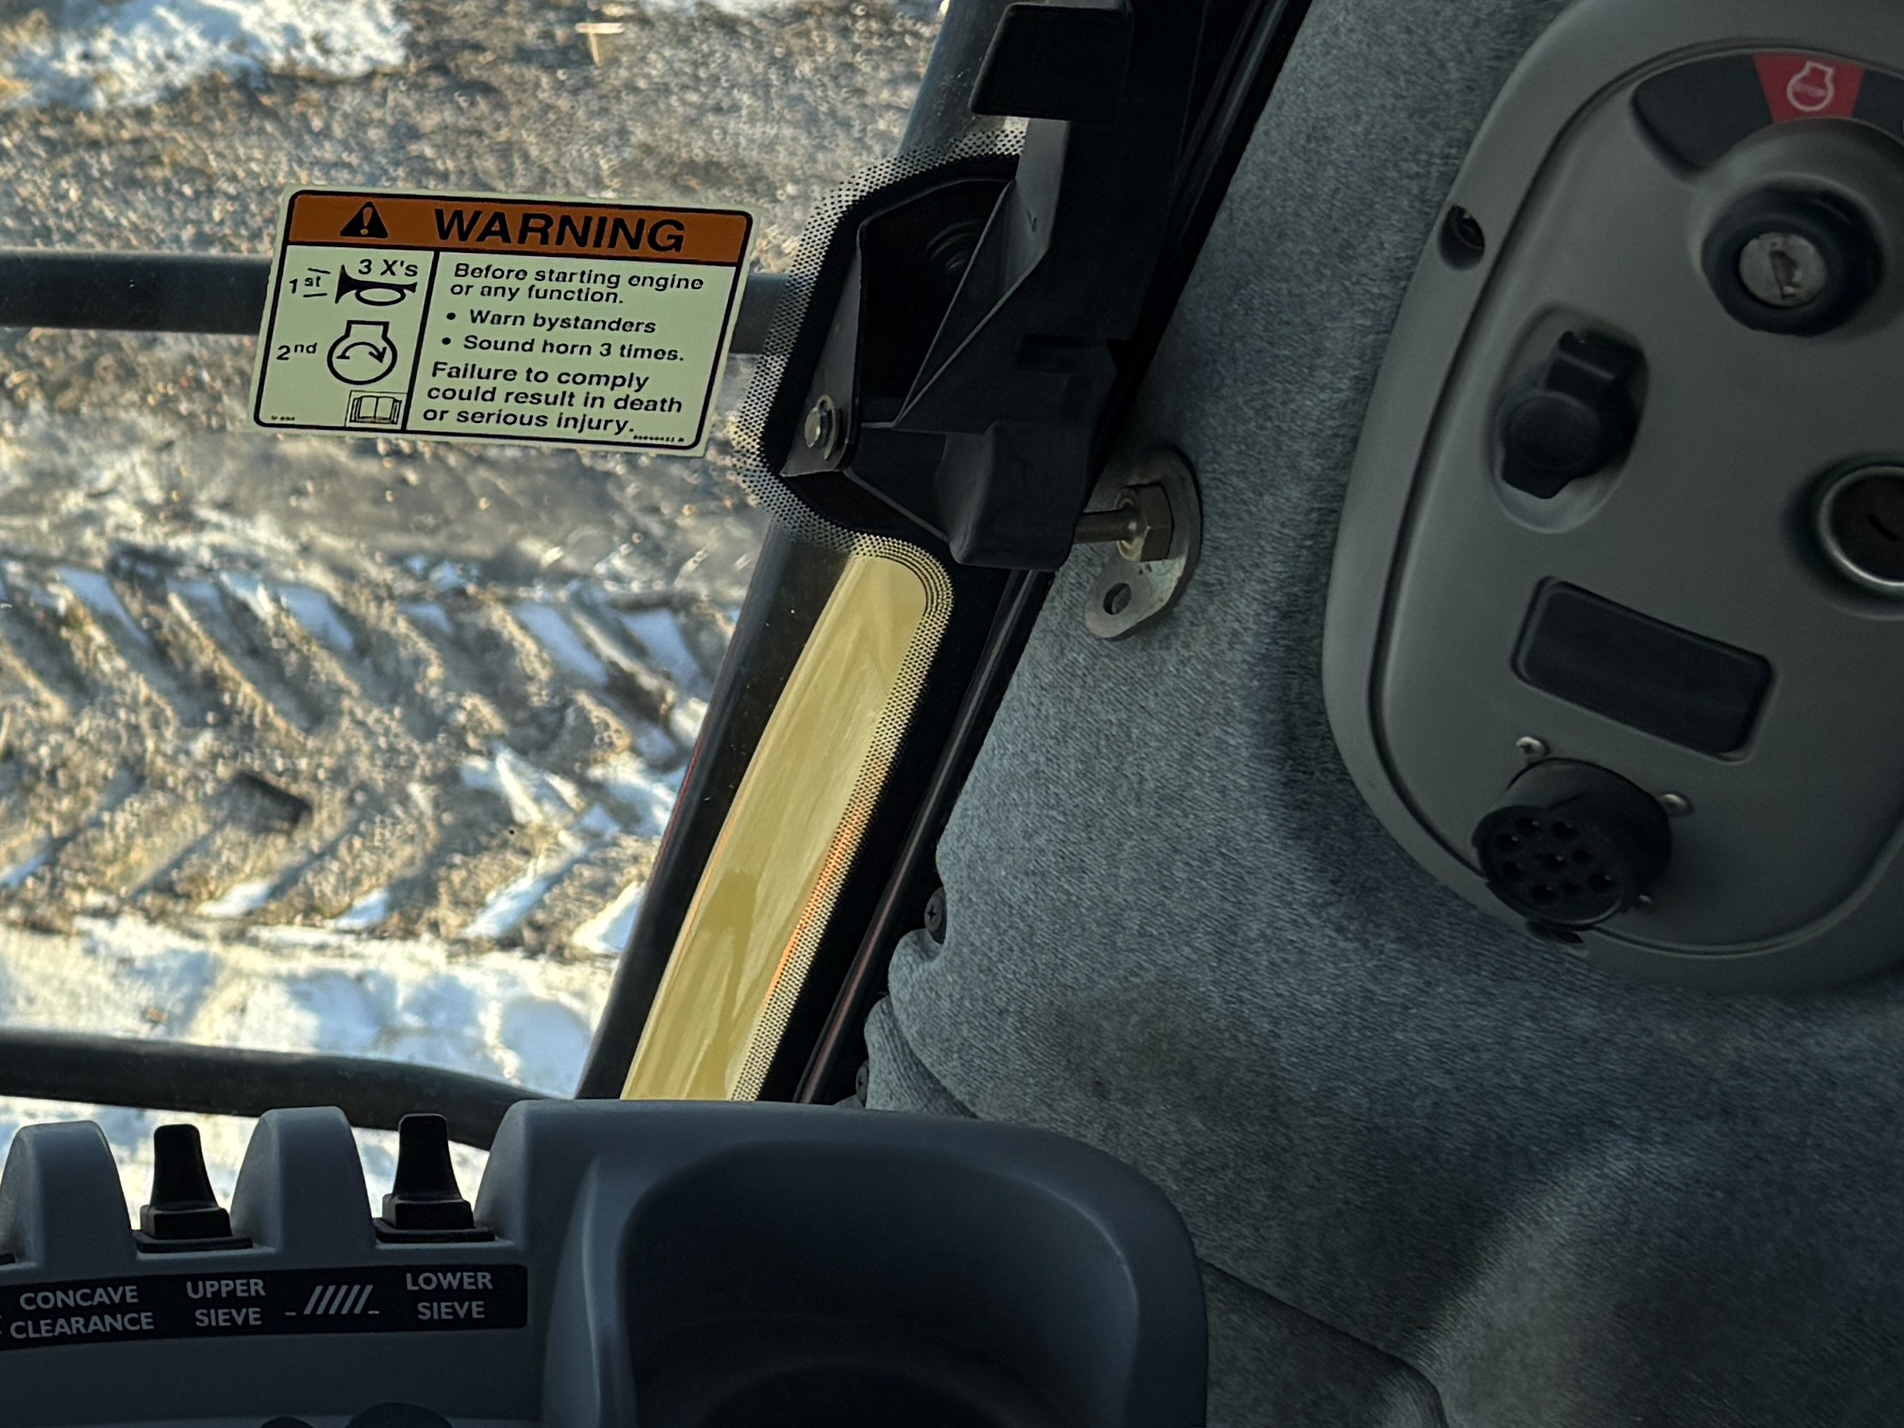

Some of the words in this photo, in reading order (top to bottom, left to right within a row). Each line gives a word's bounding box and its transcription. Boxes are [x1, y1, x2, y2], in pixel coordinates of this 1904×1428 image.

[435, 209, 685, 252] WARNING
[358, 259, 372, 275] 3
[380, 259, 418, 277] X's
[454, 263, 528, 281] Before
[534, 269, 620, 289] starting
[628, 274, 704, 292] engine
[450, 284, 474, 296] or
[480, 285, 520, 302] any
[528, 284, 623, 304] function.
[470, 309, 525, 326] Warn
[533, 313, 656, 333] bystanders
[276, 342, 318, 360] 2nd
[463, 335, 535, 352] Sound
[542, 339, 592, 356] horn
[599, 343, 612, 357] 3
[620, 344, 683, 361] times.
[432, 361, 518, 382] Failure
[525, 367, 549, 383] to
[557, 372, 649, 393] comply
[427, 386, 497, 402] could
[504, 391, 576, 407] result
[583, 391, 605, 408] in
[613, 394, 682, 413] death
[423, 409, 449, 421] or
[456, 409, 548, 427] serious
[557, 412, 634, 435] injury.
[186, 1278, 267, 1299] UPPER
[405, 1272, 493, 1291] LOWER
[19, 1285, 140, 1311] CONCAVE
[416, 1300, 485, 1321] SIEVE
[9, 1311, 155, 1340] CLEARANCE
[194, 1307, 263, 1328] SIEVE
